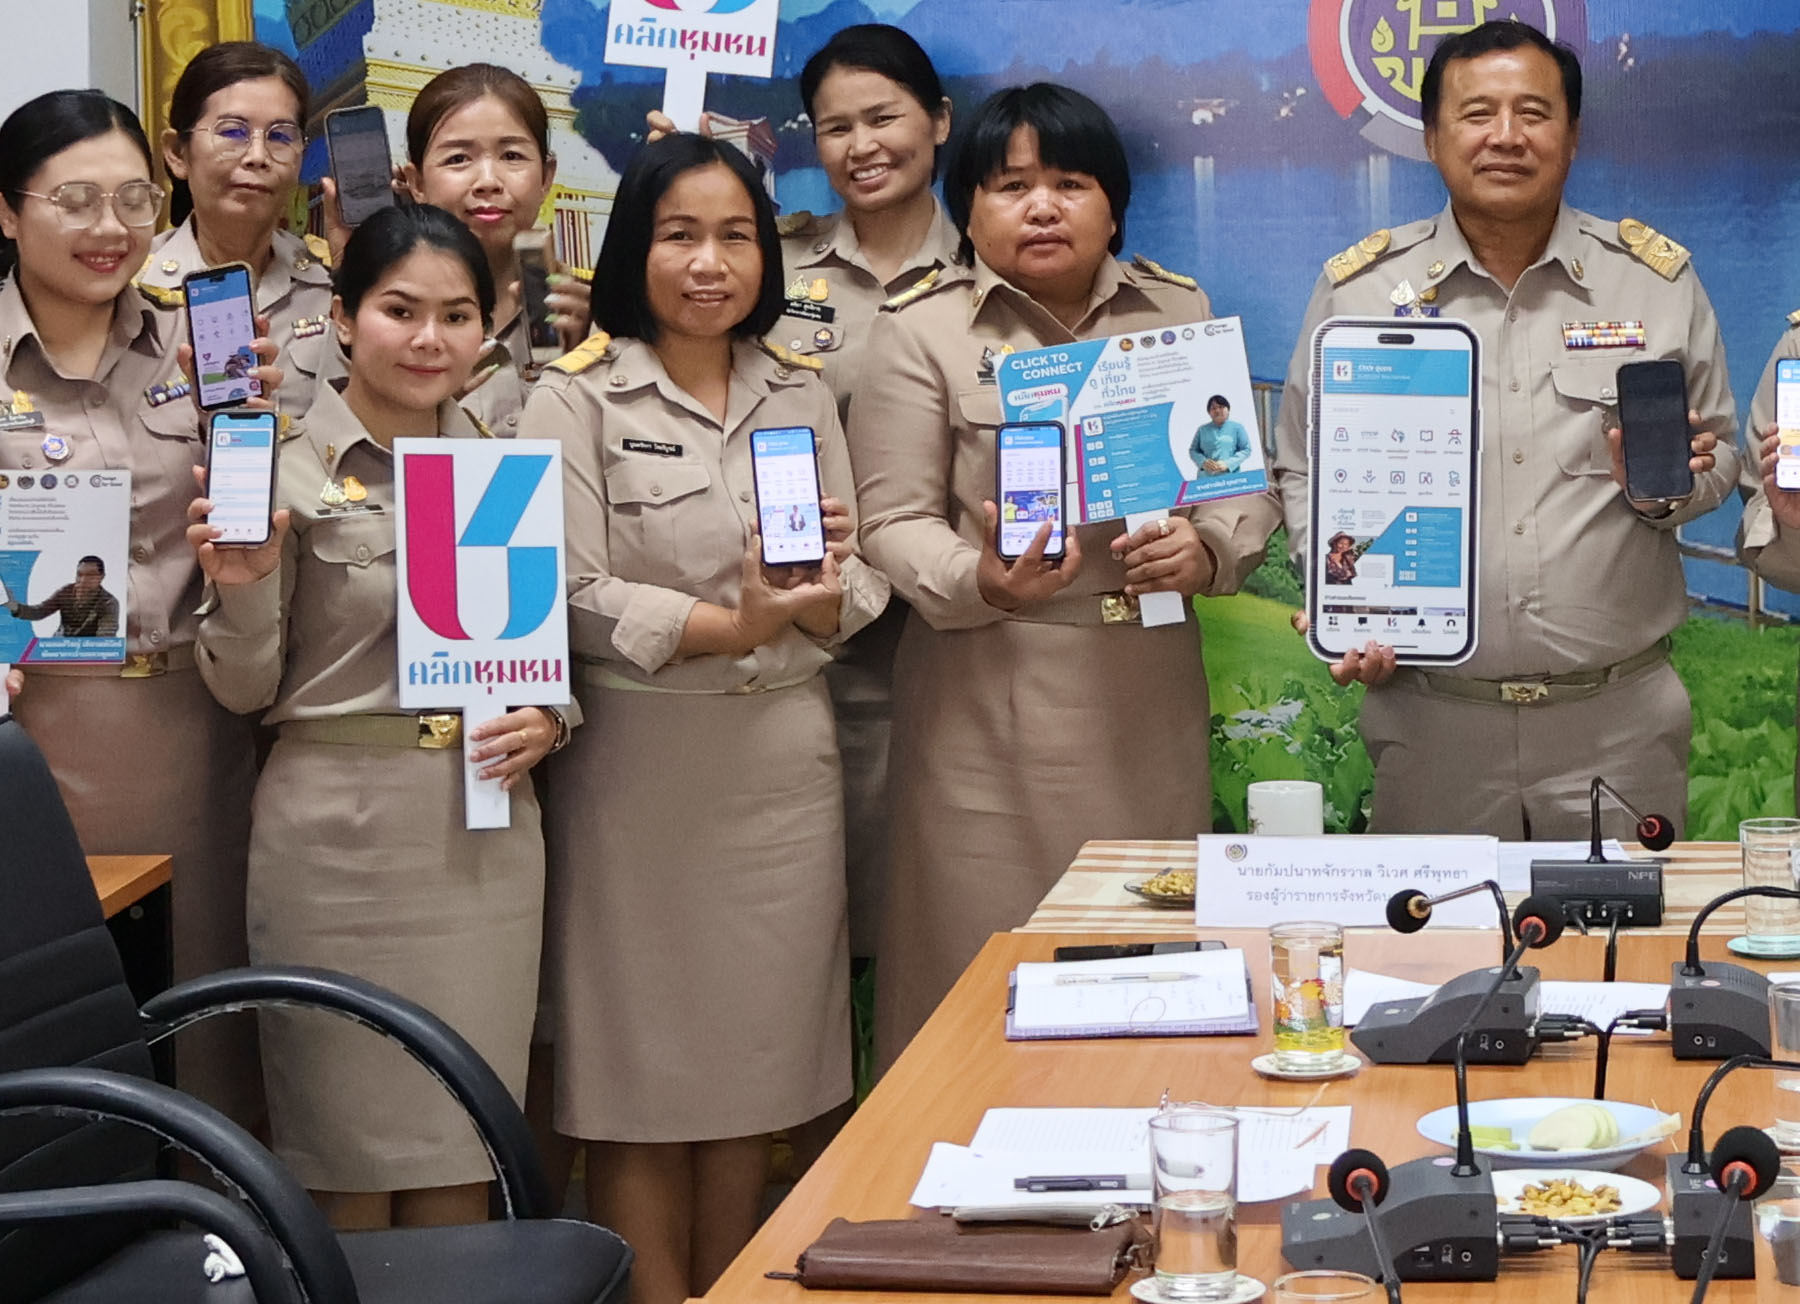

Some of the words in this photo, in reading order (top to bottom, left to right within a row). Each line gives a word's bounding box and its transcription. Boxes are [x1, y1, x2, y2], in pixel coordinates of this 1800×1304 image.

[613, 17, 767, 61] คลิกชุมชน
[1011, 356, 1049, 371] CLICK
[1050, 352, 1069, 364] TO
[1022, 361, 1083, 381] CONNECT
[408, 651, 562, 695] คลิกชุมชน
[1627, 870, 1659, 881] NPE
